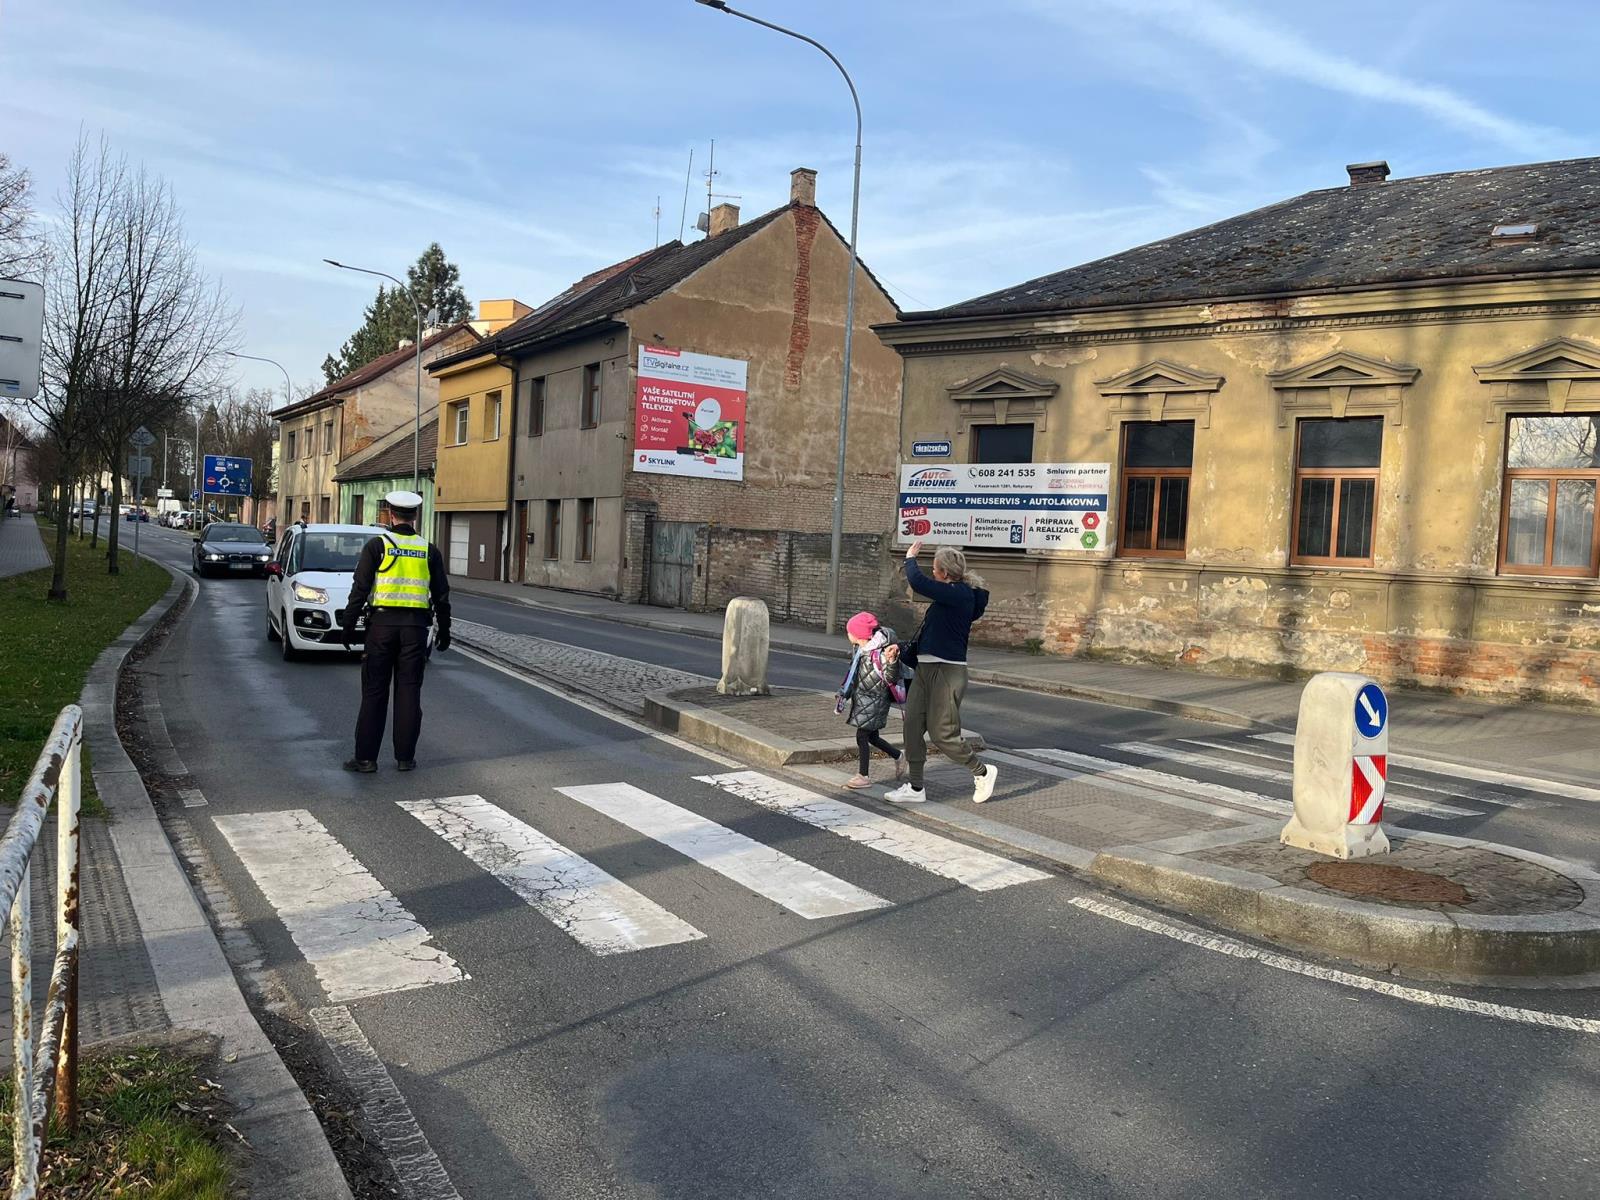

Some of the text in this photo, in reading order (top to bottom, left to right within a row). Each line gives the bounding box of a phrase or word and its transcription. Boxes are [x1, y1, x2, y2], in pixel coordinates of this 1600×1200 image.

[643, 386, 695, 398] VAŠE SATELITNÍ
[649, 395, 696, 407] INTERNETOVÁ
[641, 403, 673, 412] TELEVIZE
[651, 425, 669, 433] Montáž
[648, 457, 675, 466] SKYLINK
[978, 469, 1035, 477] 608 241 535
[1078, 468, 1107, 476] partner
[908, 477, 957, 486] BĚHOUNEK
[905, 496, 1100, 506] AUTOSERVIS PNEUSERVIS AUTOLAKOVNA
[903, 508, 925, 517] NOVÉ
[975, 517, 1016, 525] Klimatizace
[1035, 517, 1073, 525] PŘÍPRAVA
[901, 519, 931, 536] 3D
[1011, 526, 1022, 534] AC
[389, 548, 426, 557] POLICIE
